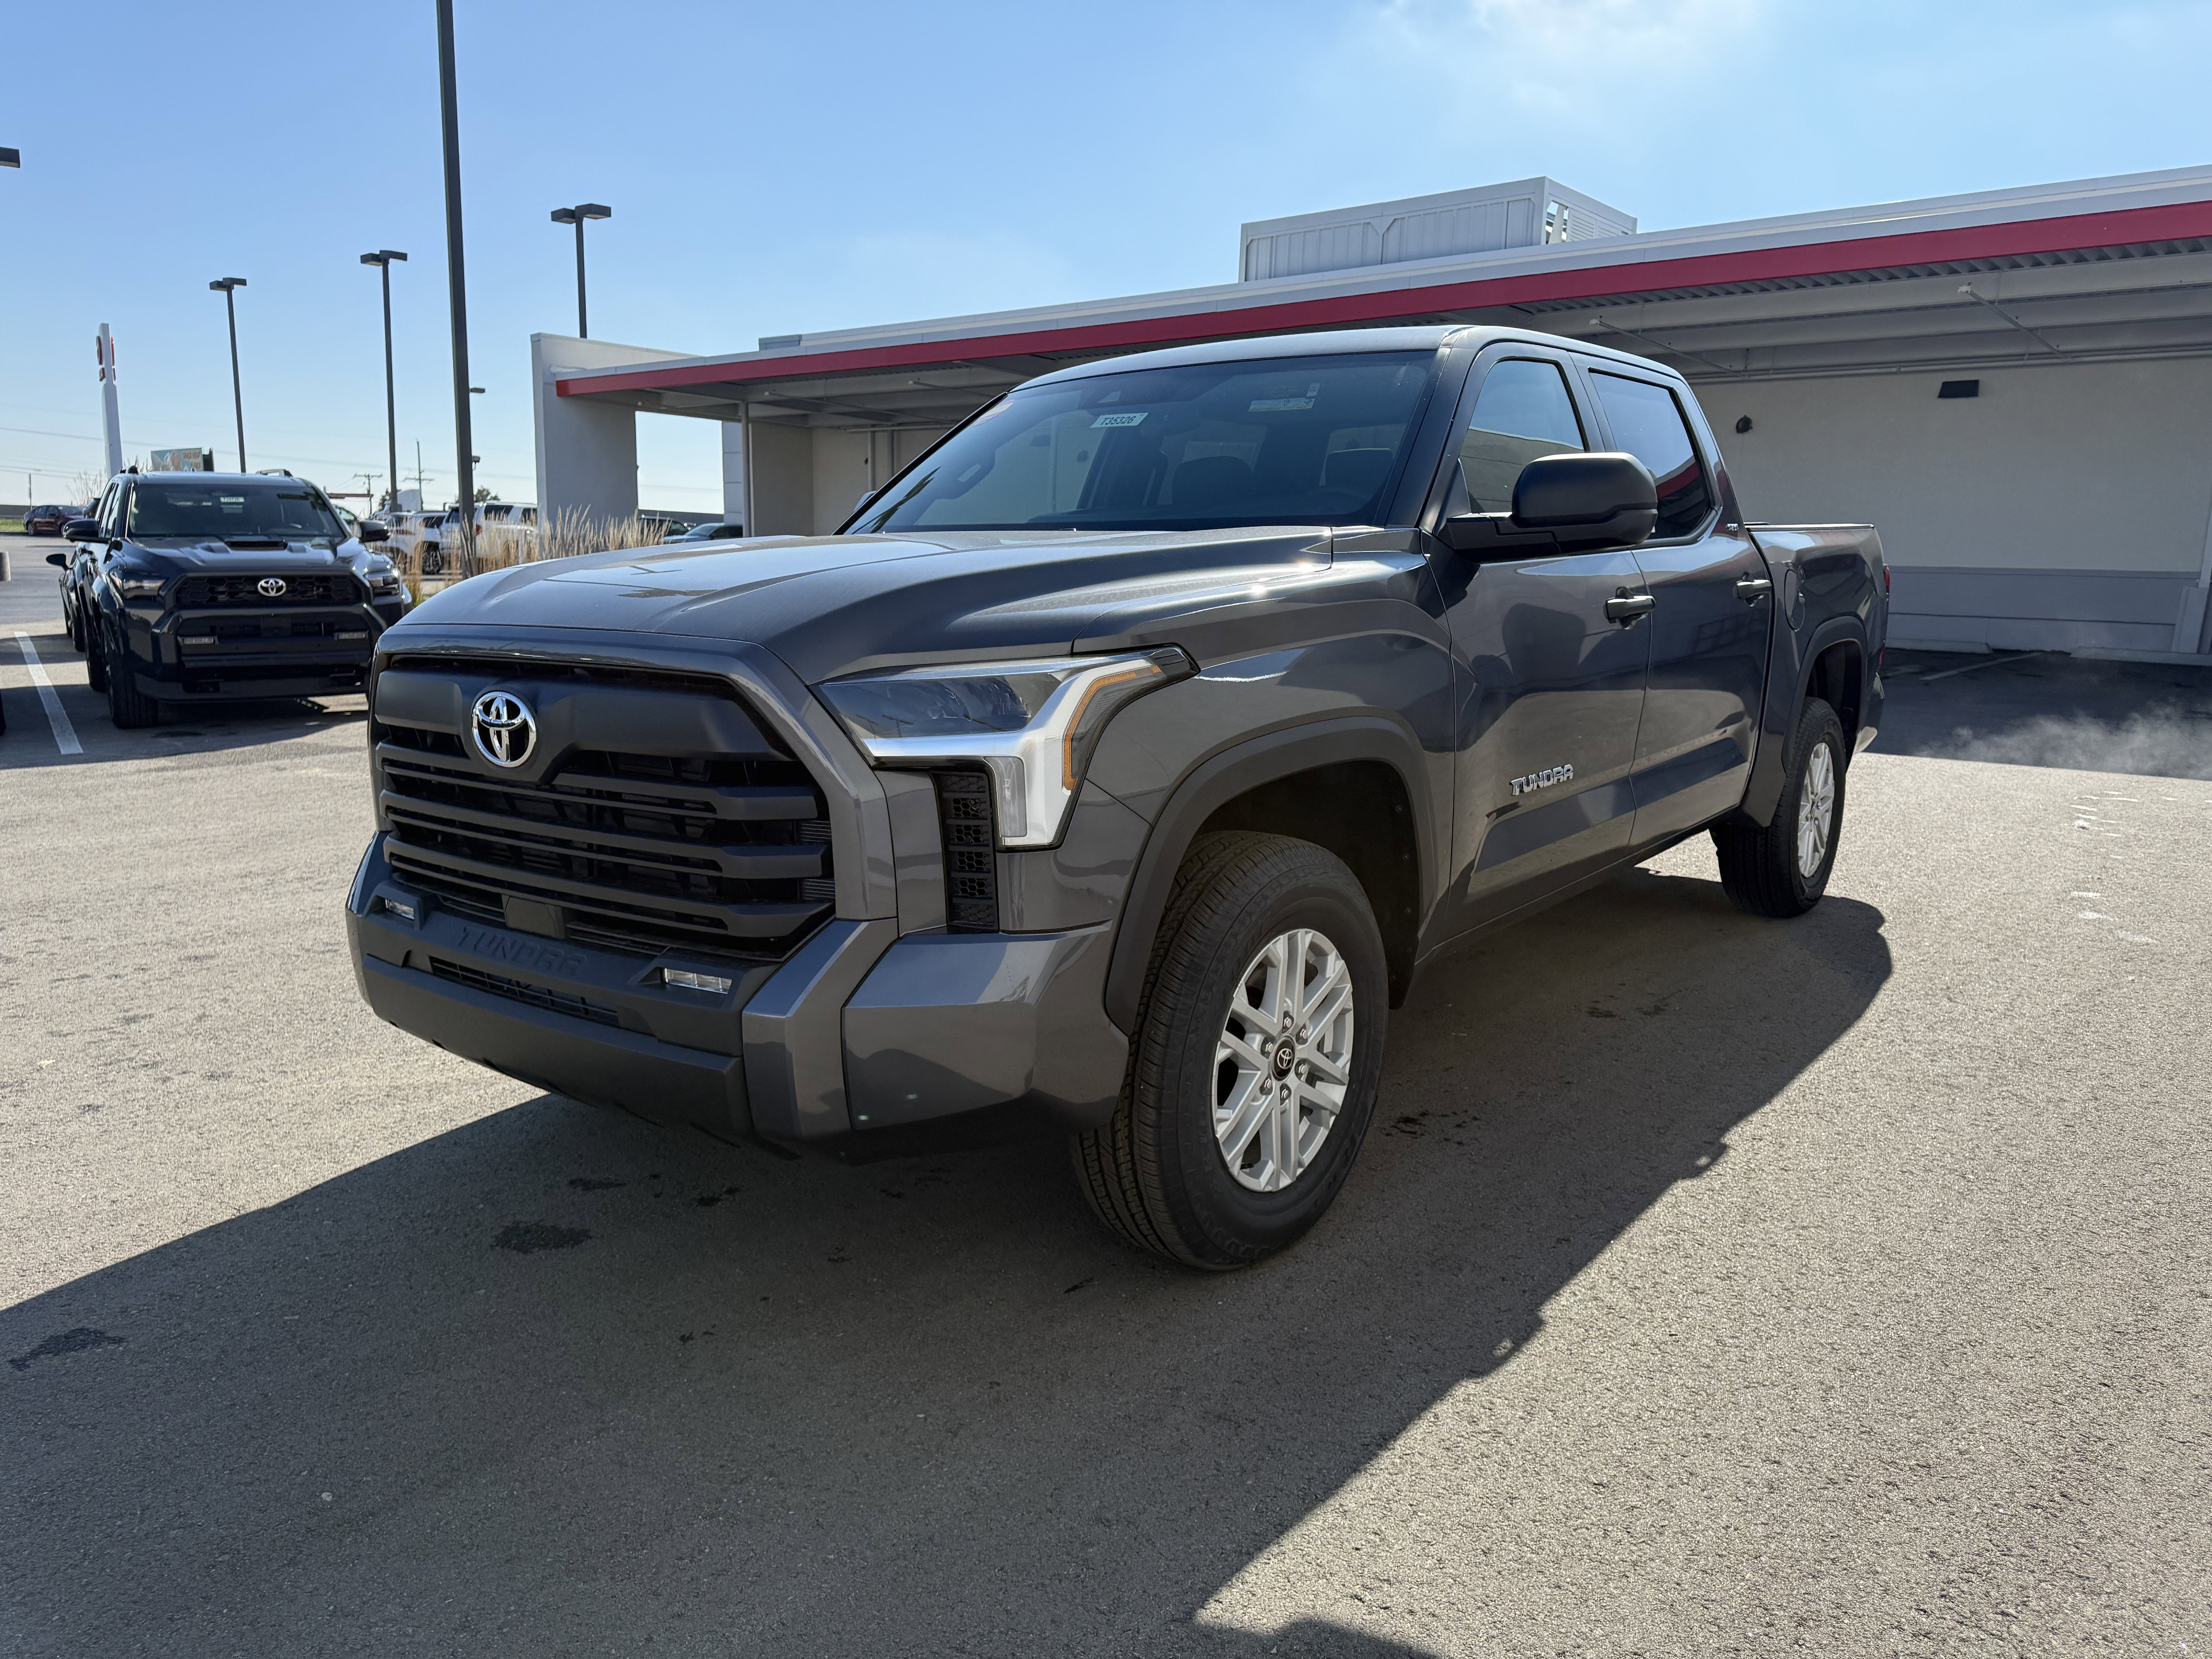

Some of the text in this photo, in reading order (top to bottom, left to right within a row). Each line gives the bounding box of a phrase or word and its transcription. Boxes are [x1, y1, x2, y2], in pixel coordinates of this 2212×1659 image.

[1101, 416, 1136, 426] T35326
[1511, 764, 1573, 796] TUNDRA
[458, 926, 587, 976] TUNDRA
